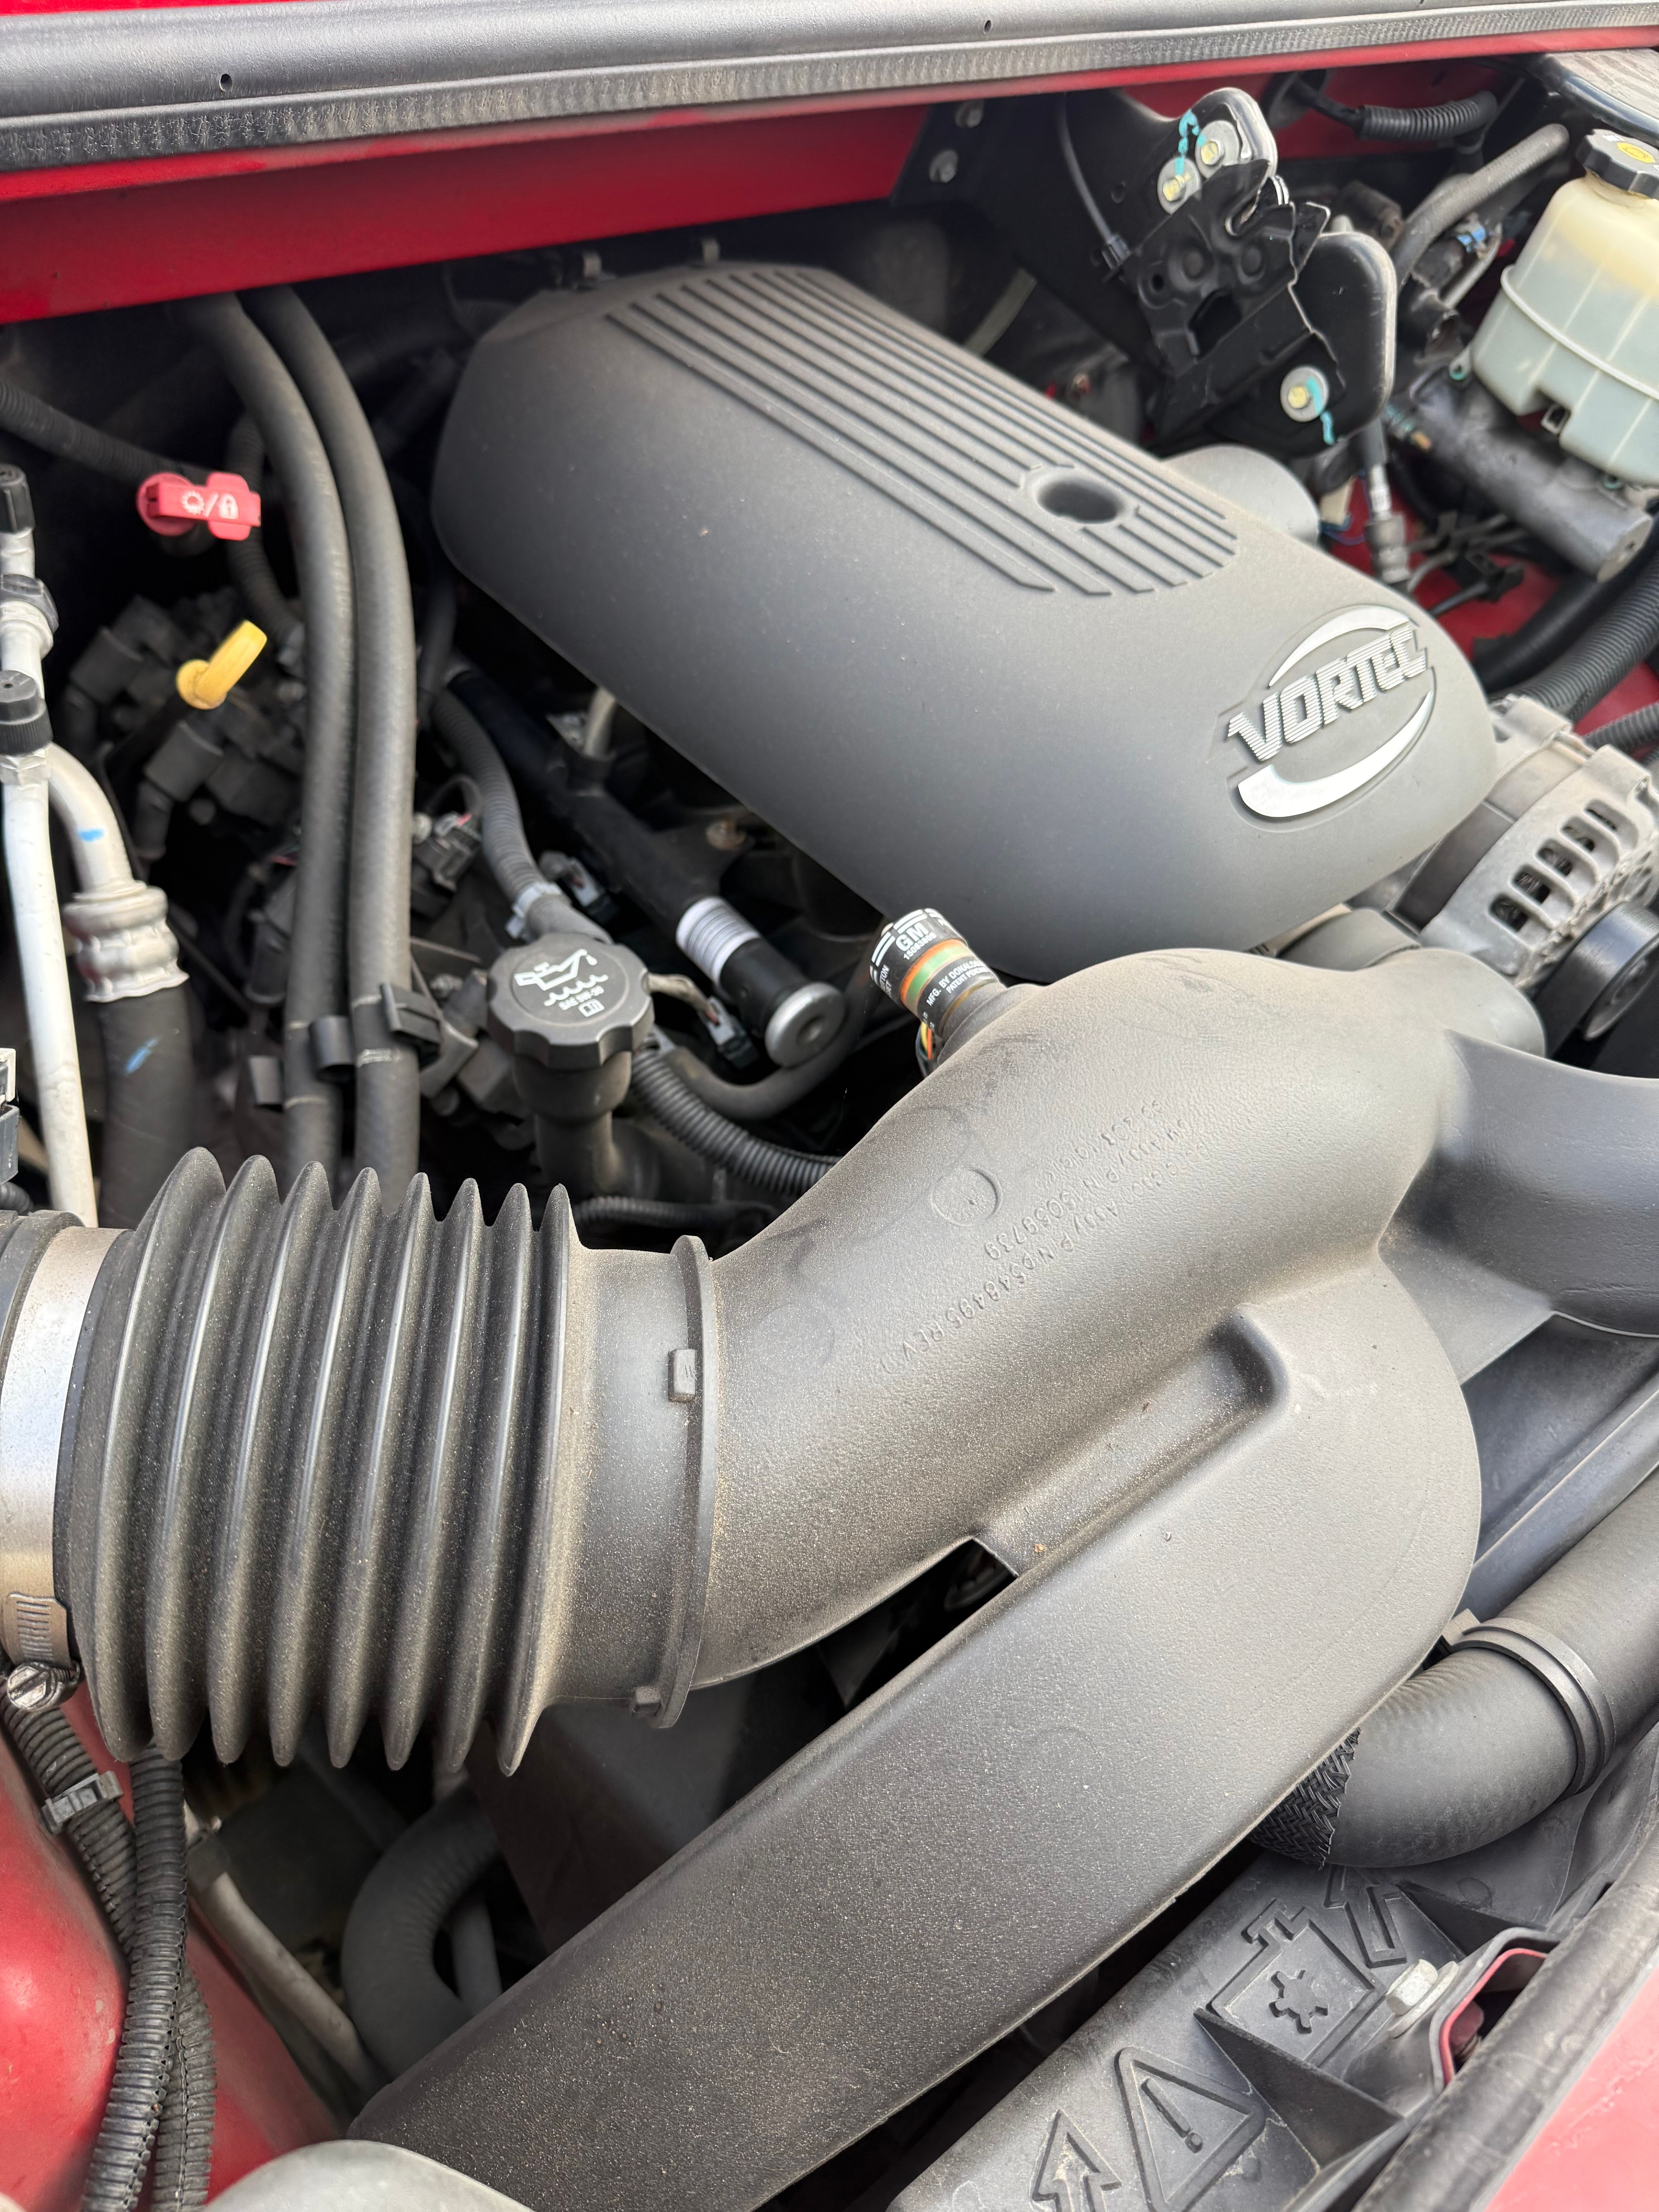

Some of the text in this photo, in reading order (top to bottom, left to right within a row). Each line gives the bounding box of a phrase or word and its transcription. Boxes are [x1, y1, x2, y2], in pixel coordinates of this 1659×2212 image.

[1228, 624, 1427, 761] VORTEC
[896, 922, 929, 951] GM
[926, 988, 942, 1006] MFG.
[939, 975, 950, 988] BY
[946, 974, 968, 993] PATENT
[899, 1321, 945, 1361] REV
